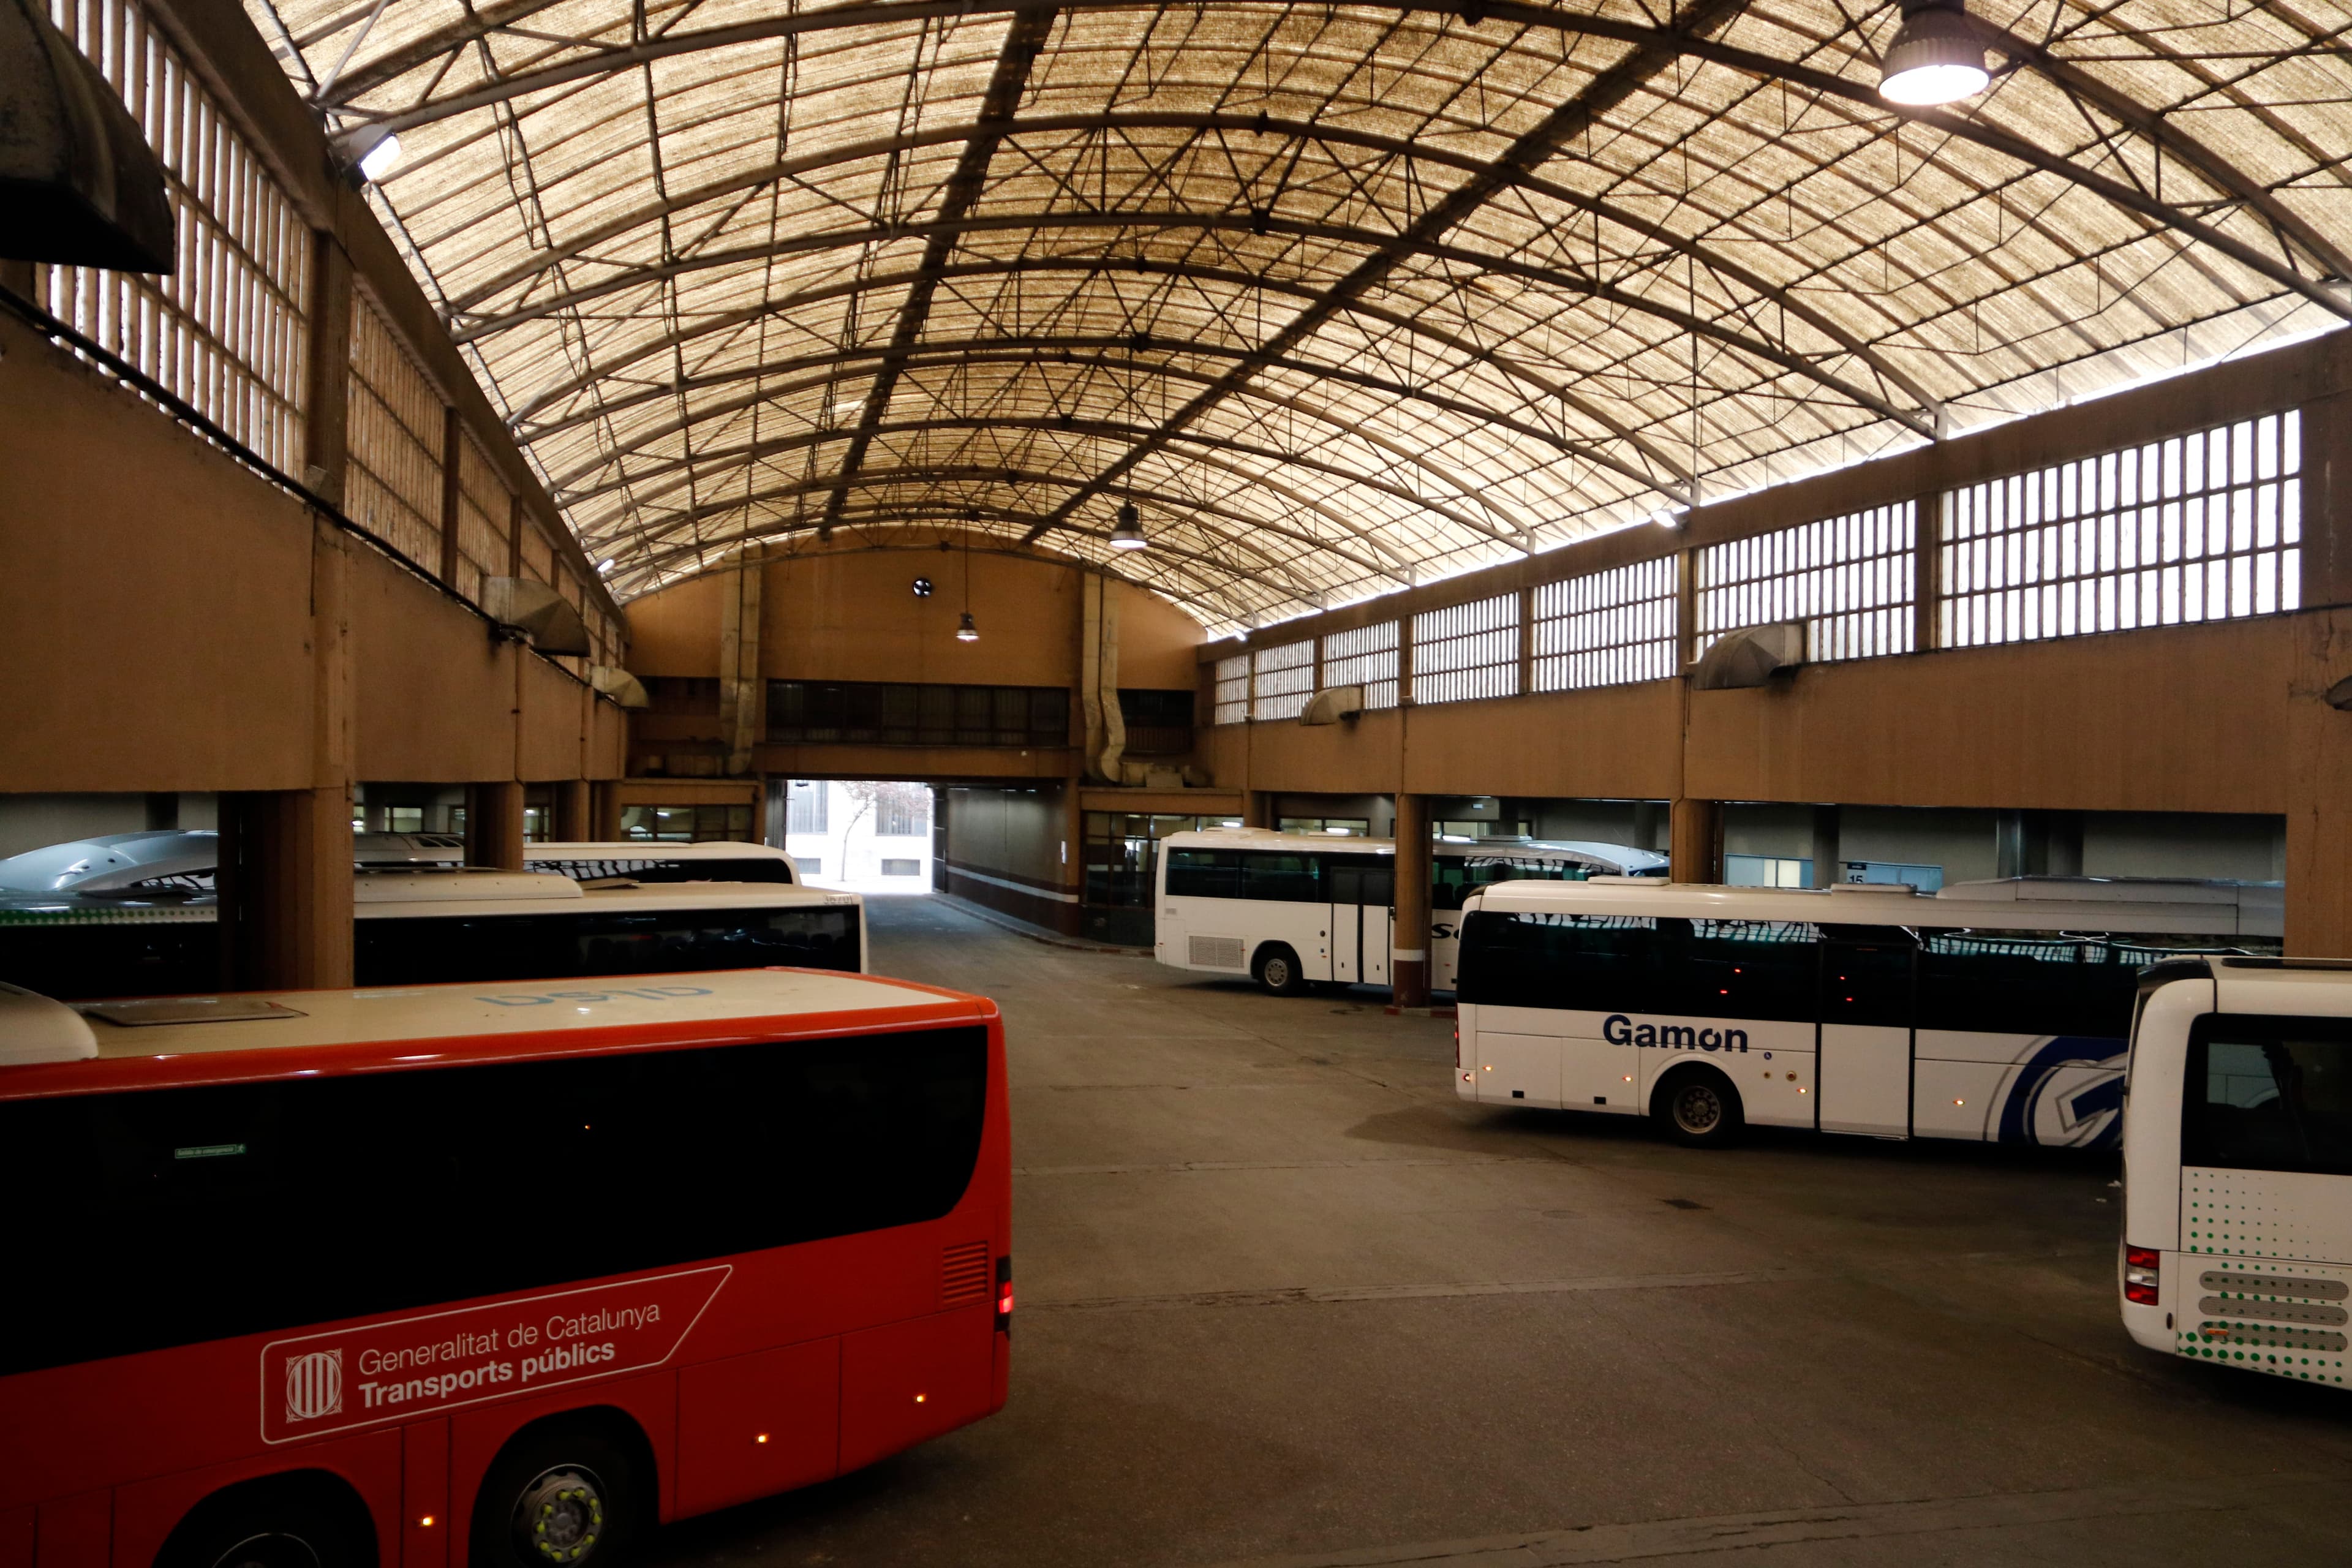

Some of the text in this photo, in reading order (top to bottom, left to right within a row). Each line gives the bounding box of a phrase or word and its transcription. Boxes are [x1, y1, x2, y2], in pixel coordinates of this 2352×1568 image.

[1603, 1014, 1749, 1053] Gamon
[357, 1338, 616, 1409] Transports públics
[358, 1303, 661, 1376] Generalitat de Catalunya
